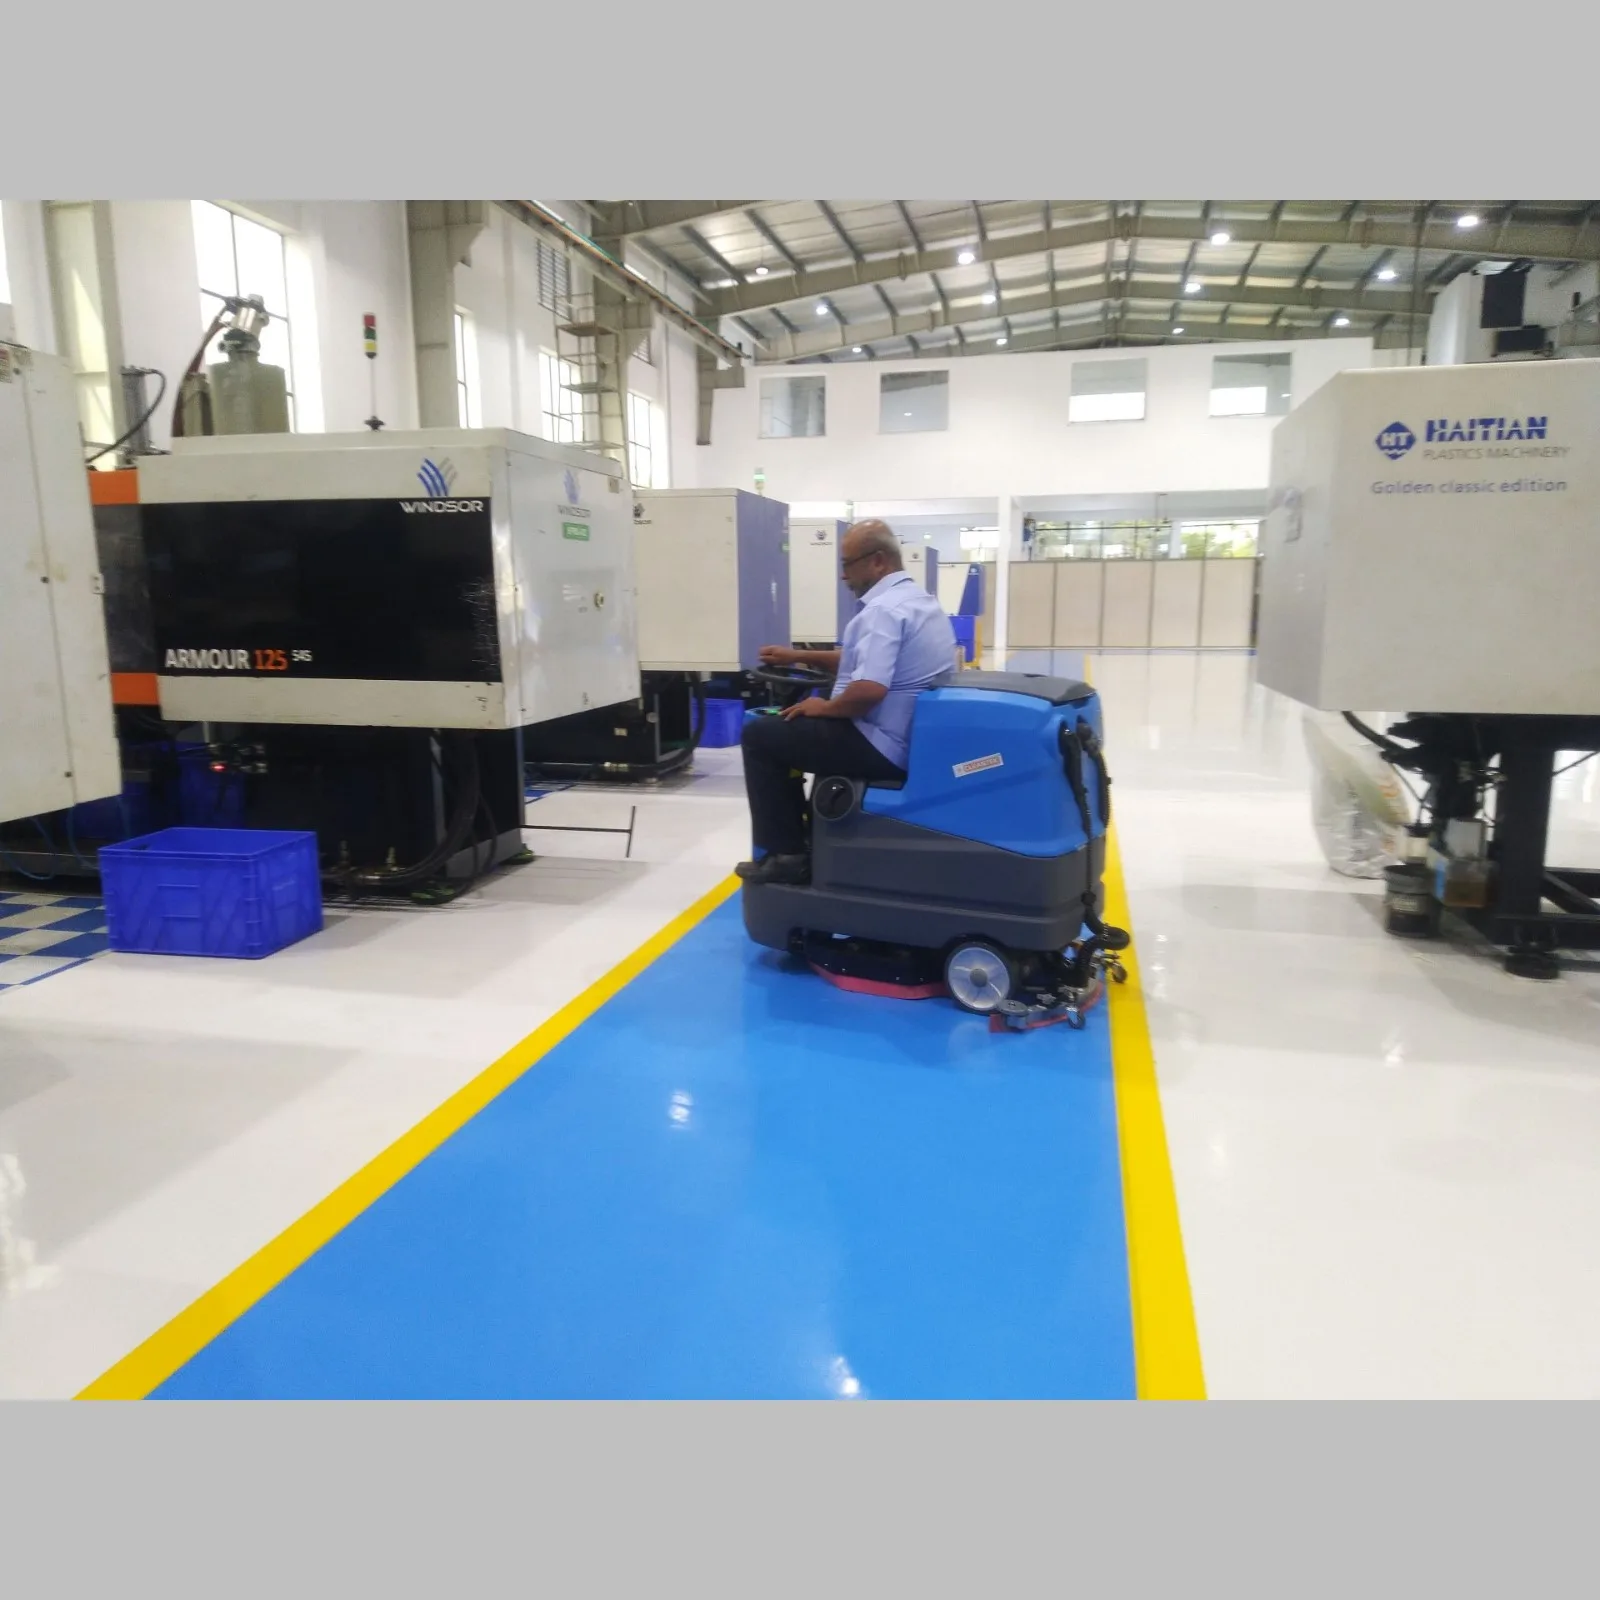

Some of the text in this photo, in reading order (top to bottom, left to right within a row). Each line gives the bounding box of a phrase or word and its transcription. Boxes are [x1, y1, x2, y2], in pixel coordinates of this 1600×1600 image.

[1425, 416, 1548, 442] HAITIAN
[1423, 446, 1571, 460] PLASTICS MACHINERY
[1370, 478, 1568, 495] Golden classic edition
[399, 500, 484, 513] WINDSOR
[165, 648, 251, 670] ARMOUR
[255, 649, 288, 671] 125
